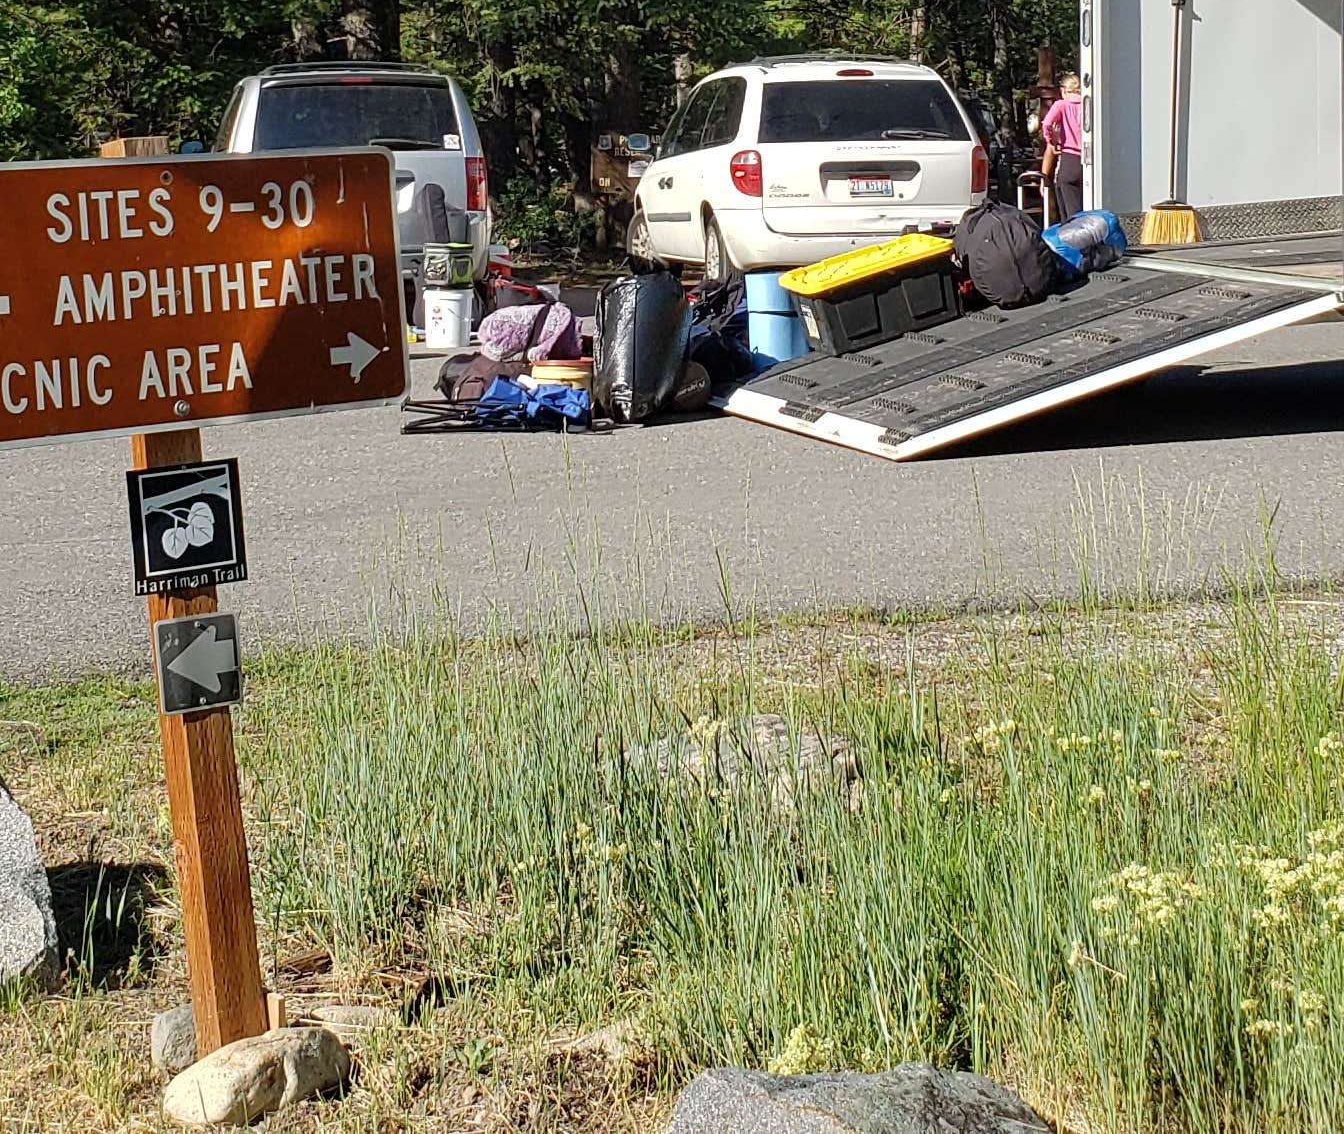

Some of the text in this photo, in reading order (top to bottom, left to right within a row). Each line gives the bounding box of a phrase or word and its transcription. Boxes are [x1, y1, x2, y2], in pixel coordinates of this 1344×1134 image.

[46, 180, 314, 243] SITES 9-30
[53, 253, 376, 326] AMPHITHEATER
[139, 341, 253, 400] AREA
[136, 564, 245, 595] Harriman Trail
